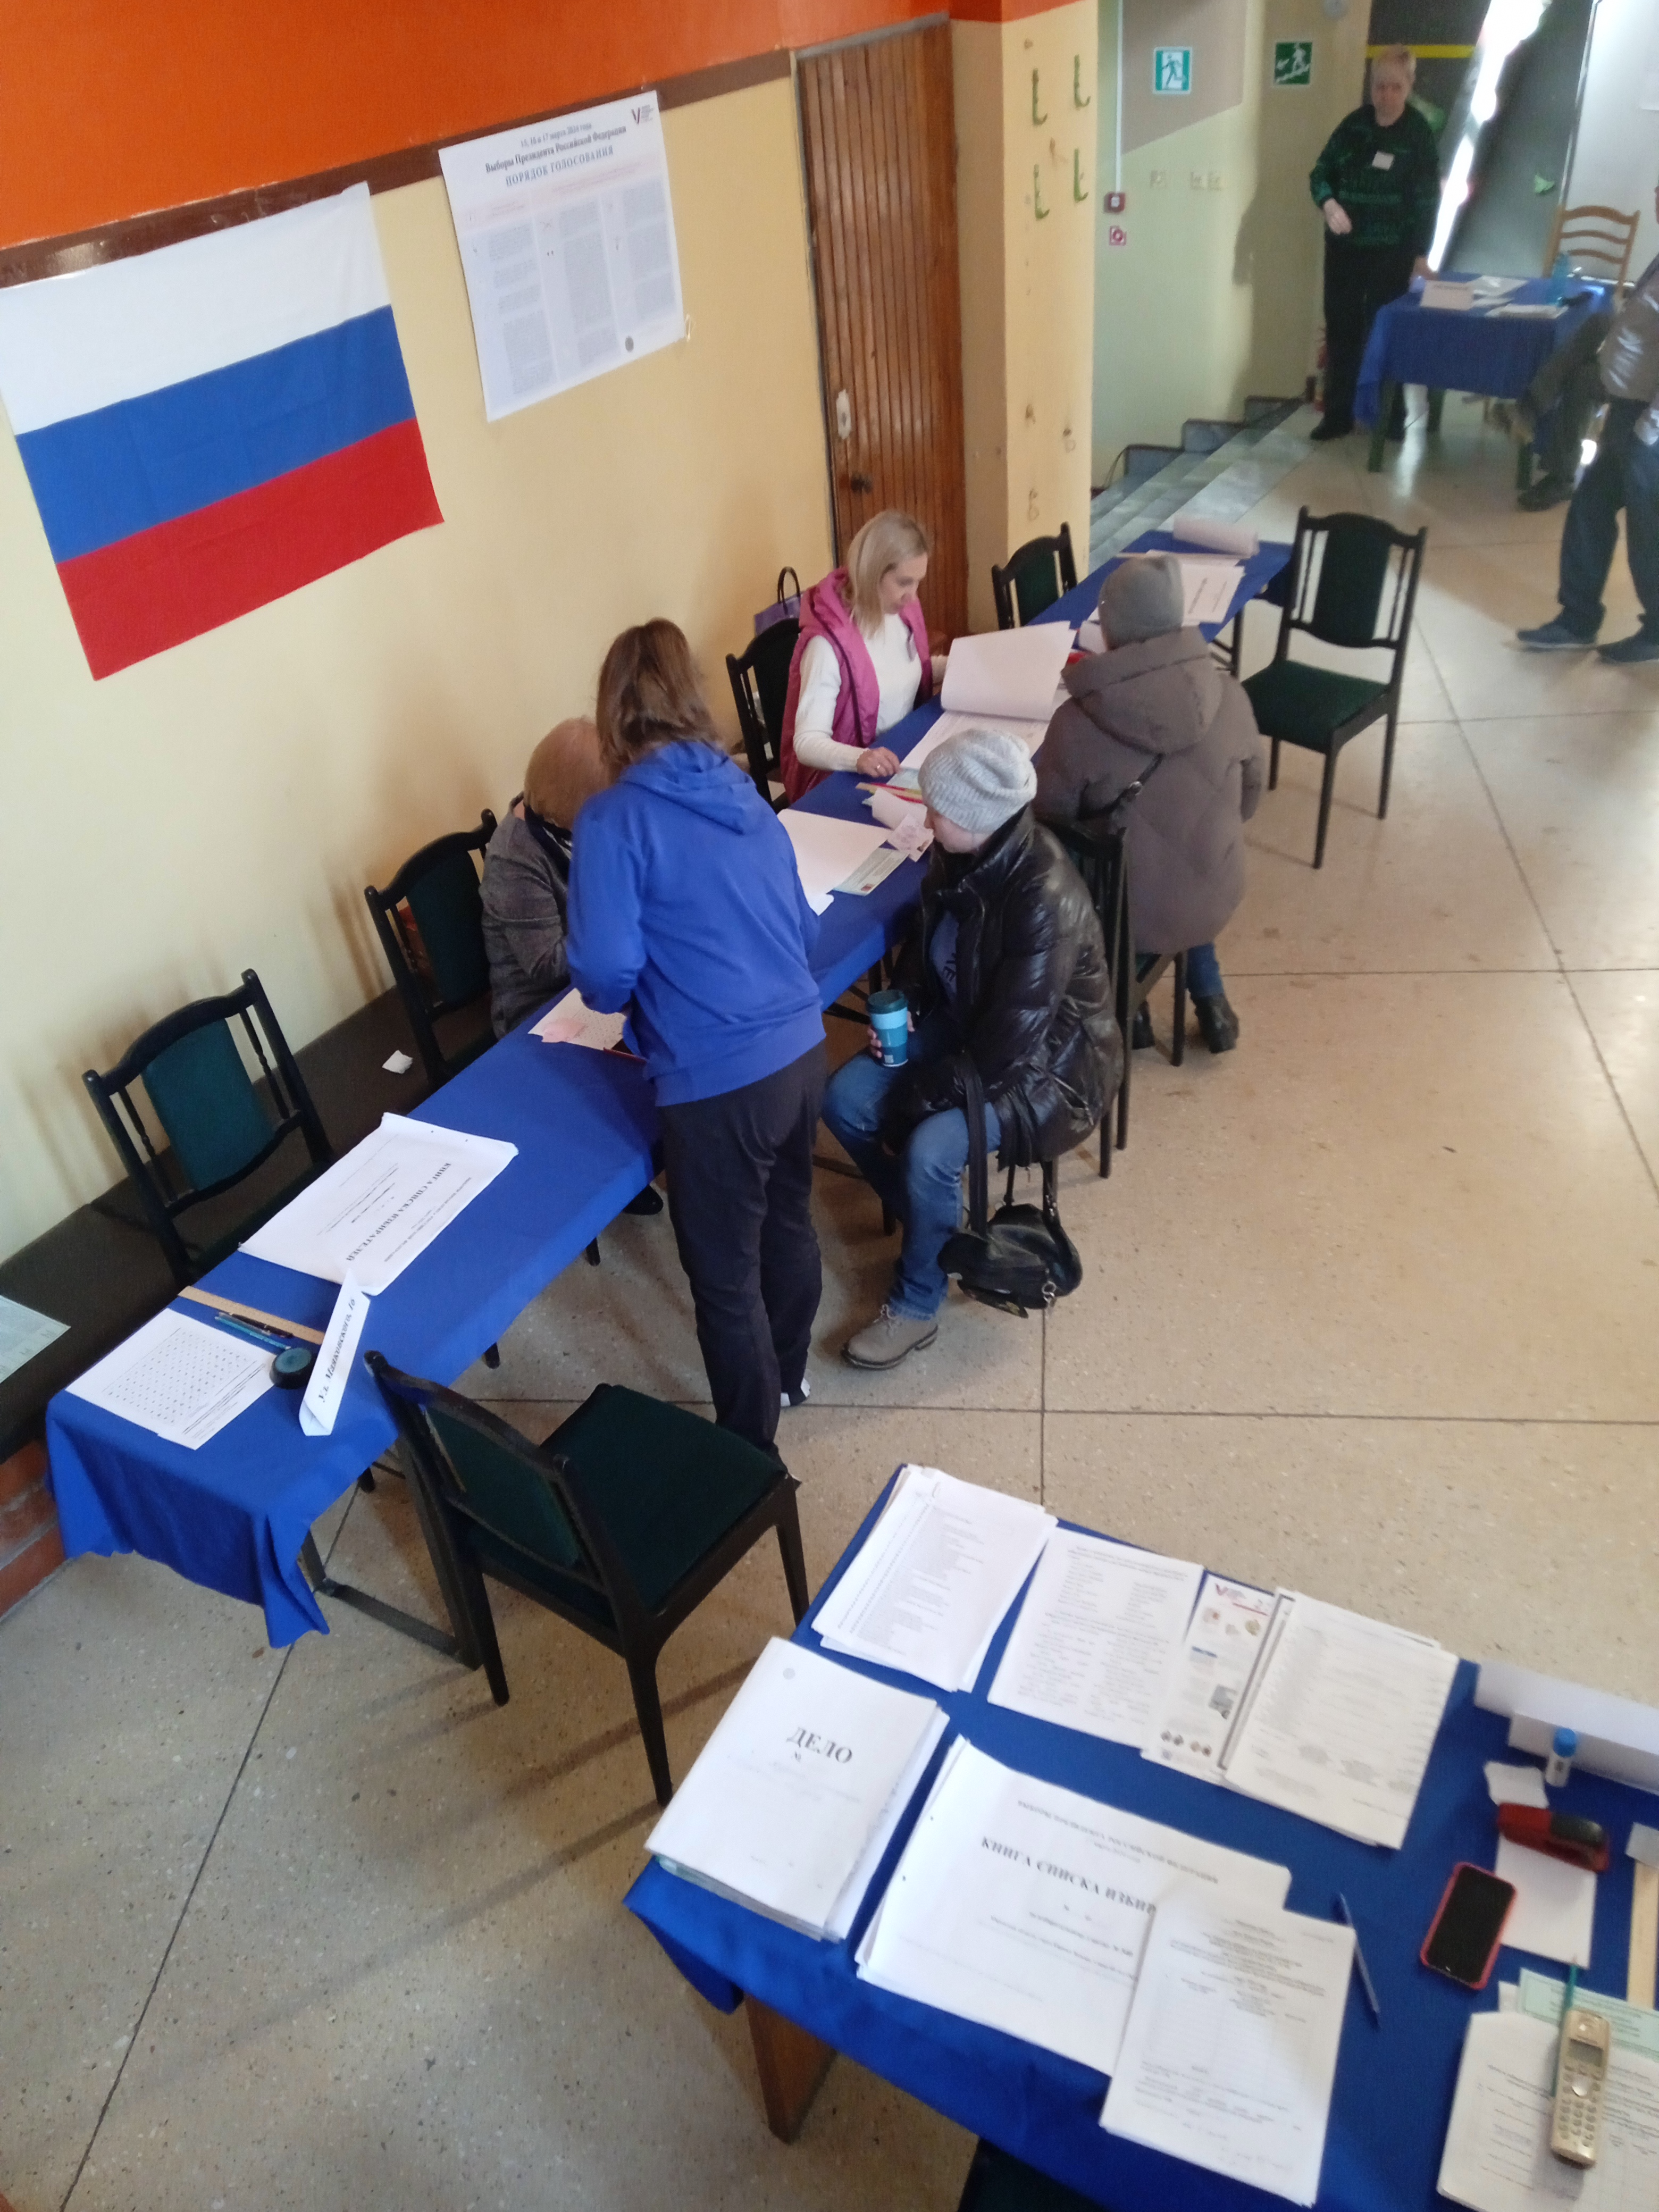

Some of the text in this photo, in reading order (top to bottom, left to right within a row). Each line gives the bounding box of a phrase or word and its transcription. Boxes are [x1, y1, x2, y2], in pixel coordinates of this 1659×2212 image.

[485, 125, 627, 174] Выборы Президента Российской Федерации
[505, 144, 614, 187] ПОРЯДОК ГОЛОСОВАНИЯ
[426, 1162, 452, 1185] КНИГА
[397, 1185, 428, 1213] СПИСКА
[346, 1213, 399, 1262] ИЗБИРАТЕЛЕЙ
[786, 1727, 853, 1763] ДЕЛО
[981, 1835, 1032, 1867] КНИГА
[1036, 1859, 1100, 1896] СПИСКА
